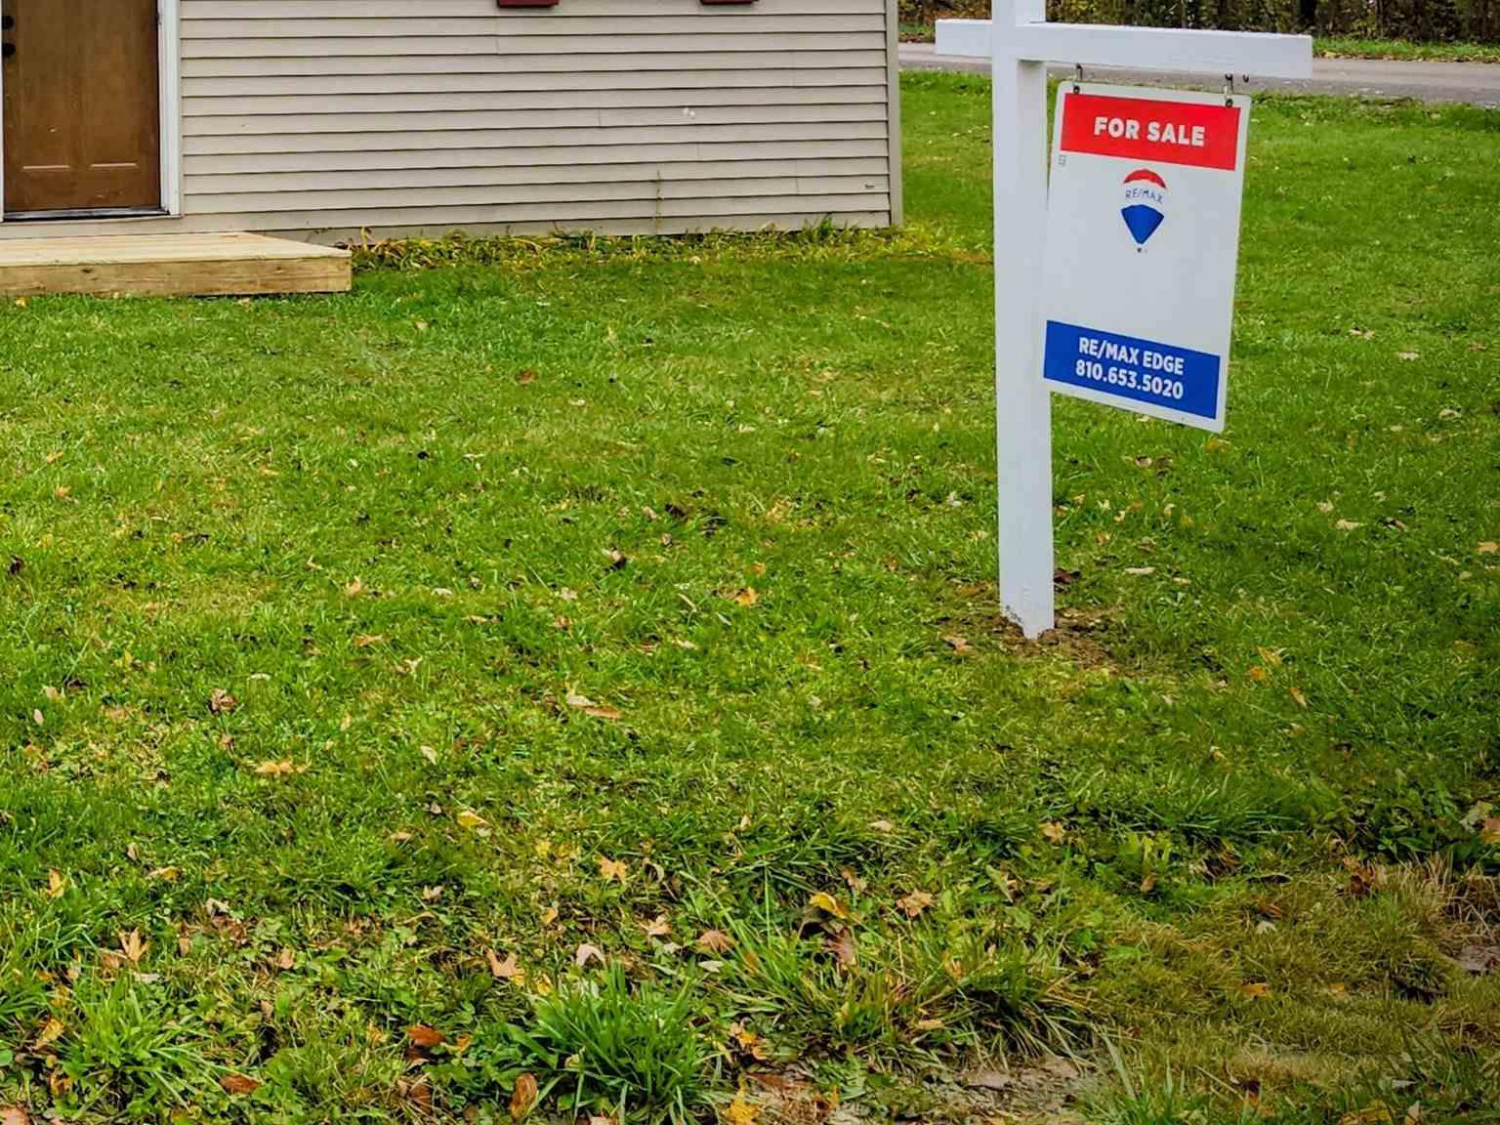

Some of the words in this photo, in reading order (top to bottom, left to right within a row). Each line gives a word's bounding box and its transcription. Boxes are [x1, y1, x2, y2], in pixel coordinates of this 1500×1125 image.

[1094, 116, 1141, 140] FOR
[1147, 122, 1205, 147] SALE
[1125, 188, 1164, 203] RE/MAX
[1078, 336, 1139, 364] RE/MAX
[1143, 352, 1184, 375] EDGE
[1076, 360, 1184, 400] 810.653.5020
